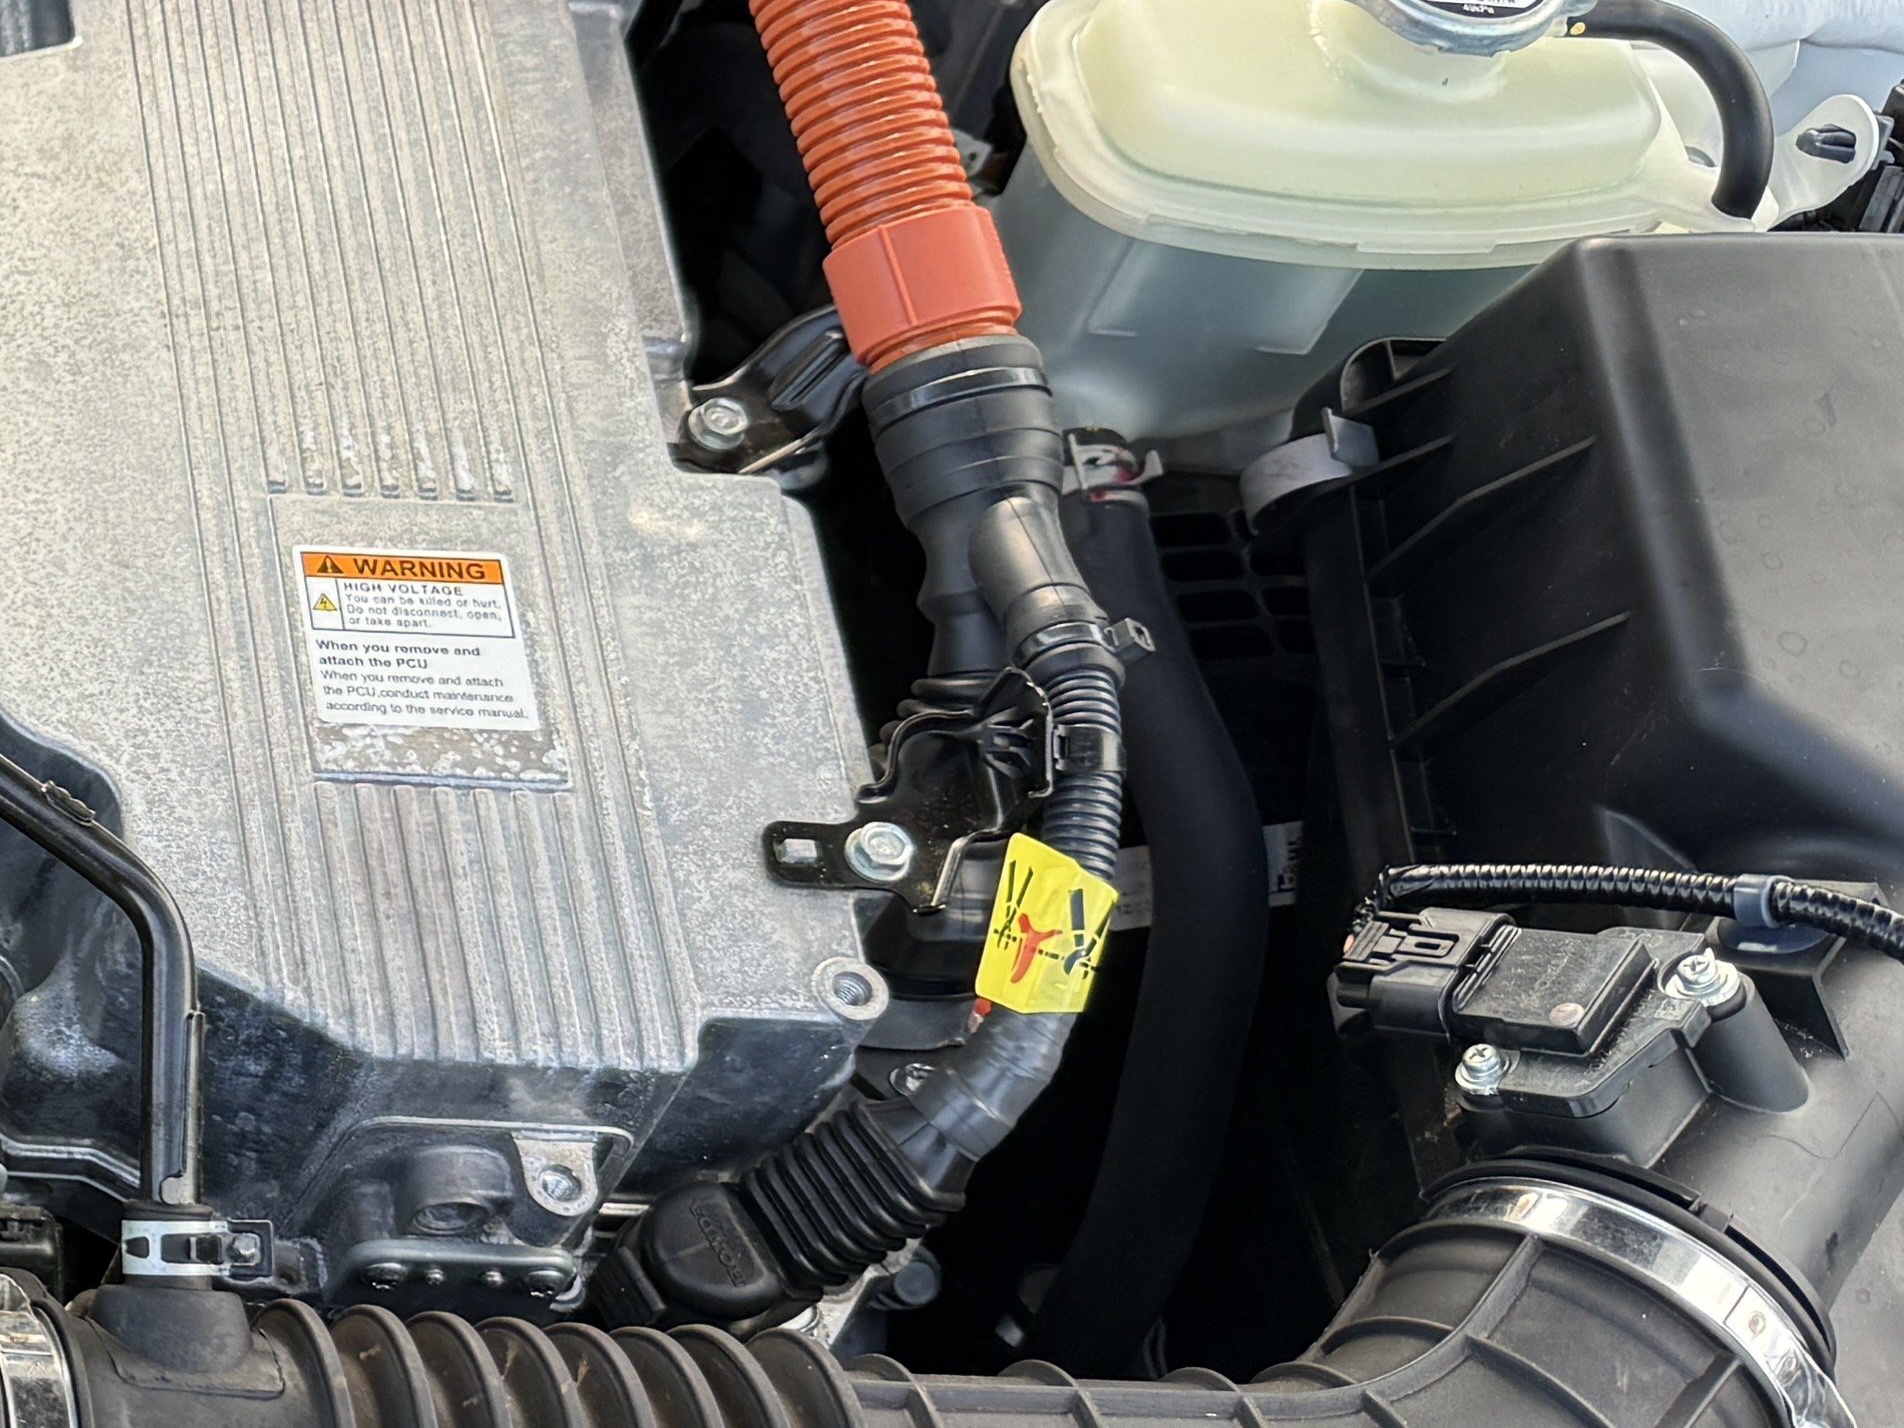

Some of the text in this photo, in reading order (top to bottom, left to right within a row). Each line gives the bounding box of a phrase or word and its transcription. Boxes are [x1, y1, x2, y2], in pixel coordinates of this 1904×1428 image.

[353, 558, 486, 580] WARNING
[343, 582, 464, 596] HIGH VOLTAGE
[345, 593, 369, 603] You
[373, 596, 395, 604] can
[399, 596, 414, 605] be
[419, 596, 451, 606] killed
[456, 599, 468, 607] or
[347, 605, 363, 614] Do
[369, 605, 387, 615] not
[349, 616, 431, 629] or take apart.
[316, 640, 480, 656] When you remove and
[320, 656, 428, 669] attach the PCU
[321, 670, 504, 687] When you remove and attach
[324, 685, 342, 696] the
[433, 690, 513, 702] maintenance
[326, 701, 386, 715] according
[390, 703, 402, 713] to
[406, 703, 426, 715] the
[429, 706, 474, 717] service
